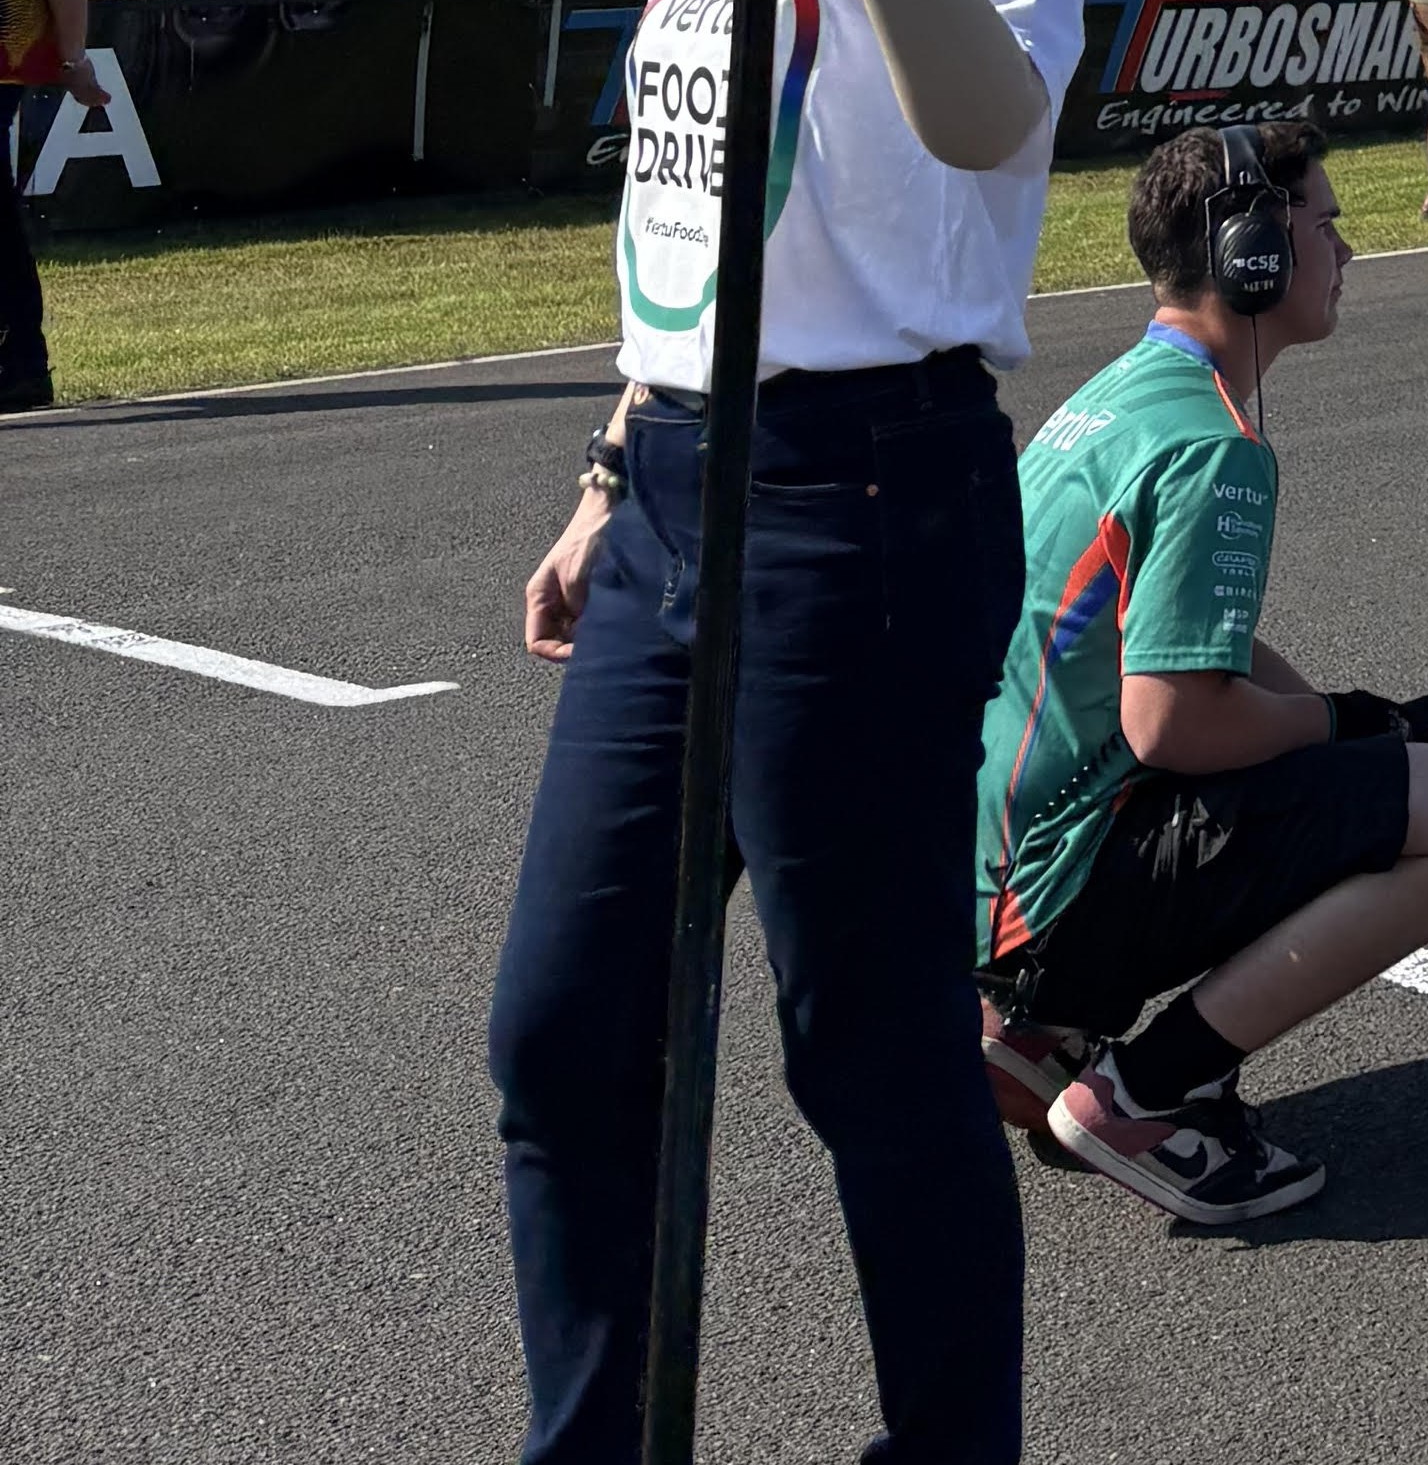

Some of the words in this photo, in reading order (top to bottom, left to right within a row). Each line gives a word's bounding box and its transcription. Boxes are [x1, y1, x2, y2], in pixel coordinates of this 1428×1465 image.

[8, 47, 162, 198] A
[1097, 91, 1312, 135] Engineered
[1327, 89, 1362, 118] to
[635, 127, 725, 198] DRIVE
[1246, 254, 1280, 273] csg
